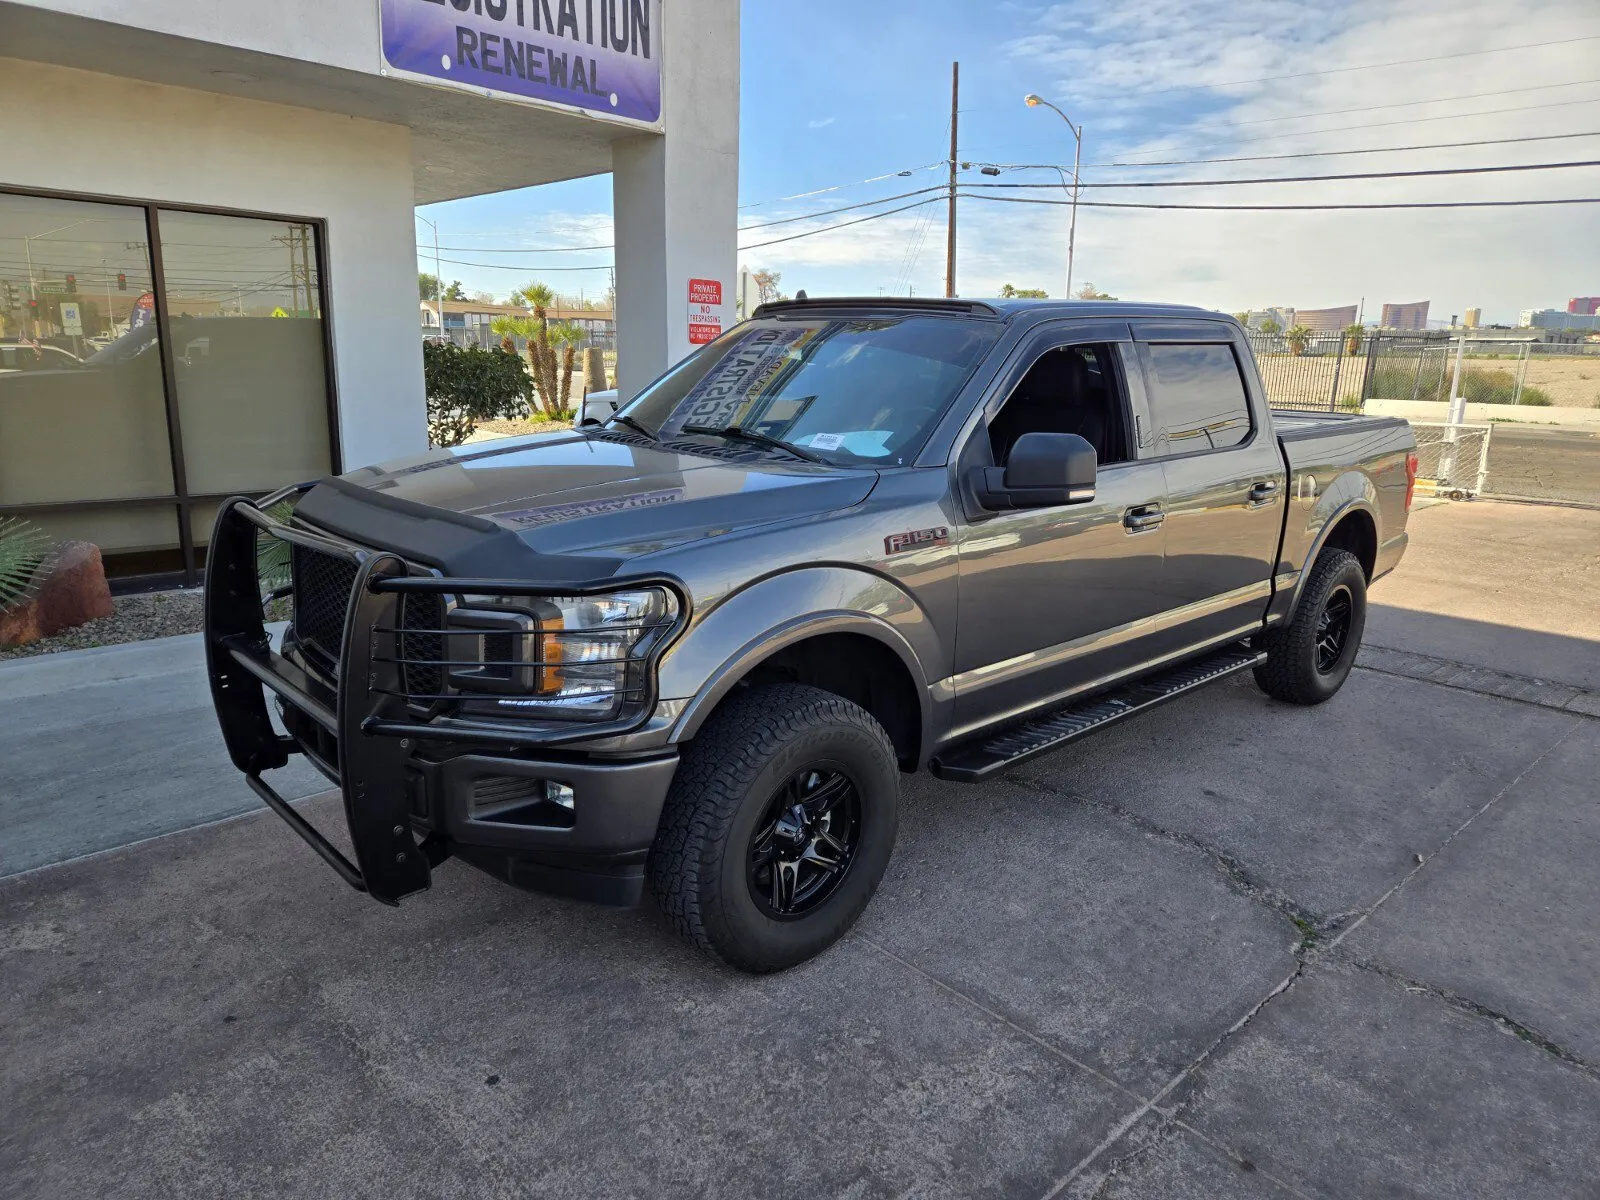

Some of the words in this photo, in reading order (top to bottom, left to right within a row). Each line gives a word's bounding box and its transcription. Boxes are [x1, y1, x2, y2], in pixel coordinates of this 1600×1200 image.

[455, 25, 608, 98] RENEWAL
[693, 284, 717, 294] PRIVATE
[690, 293, 720, 303] PROPERTY
[700, 305, 711, 314] NO
[690, 314, 721, 324] TRESPASSING
